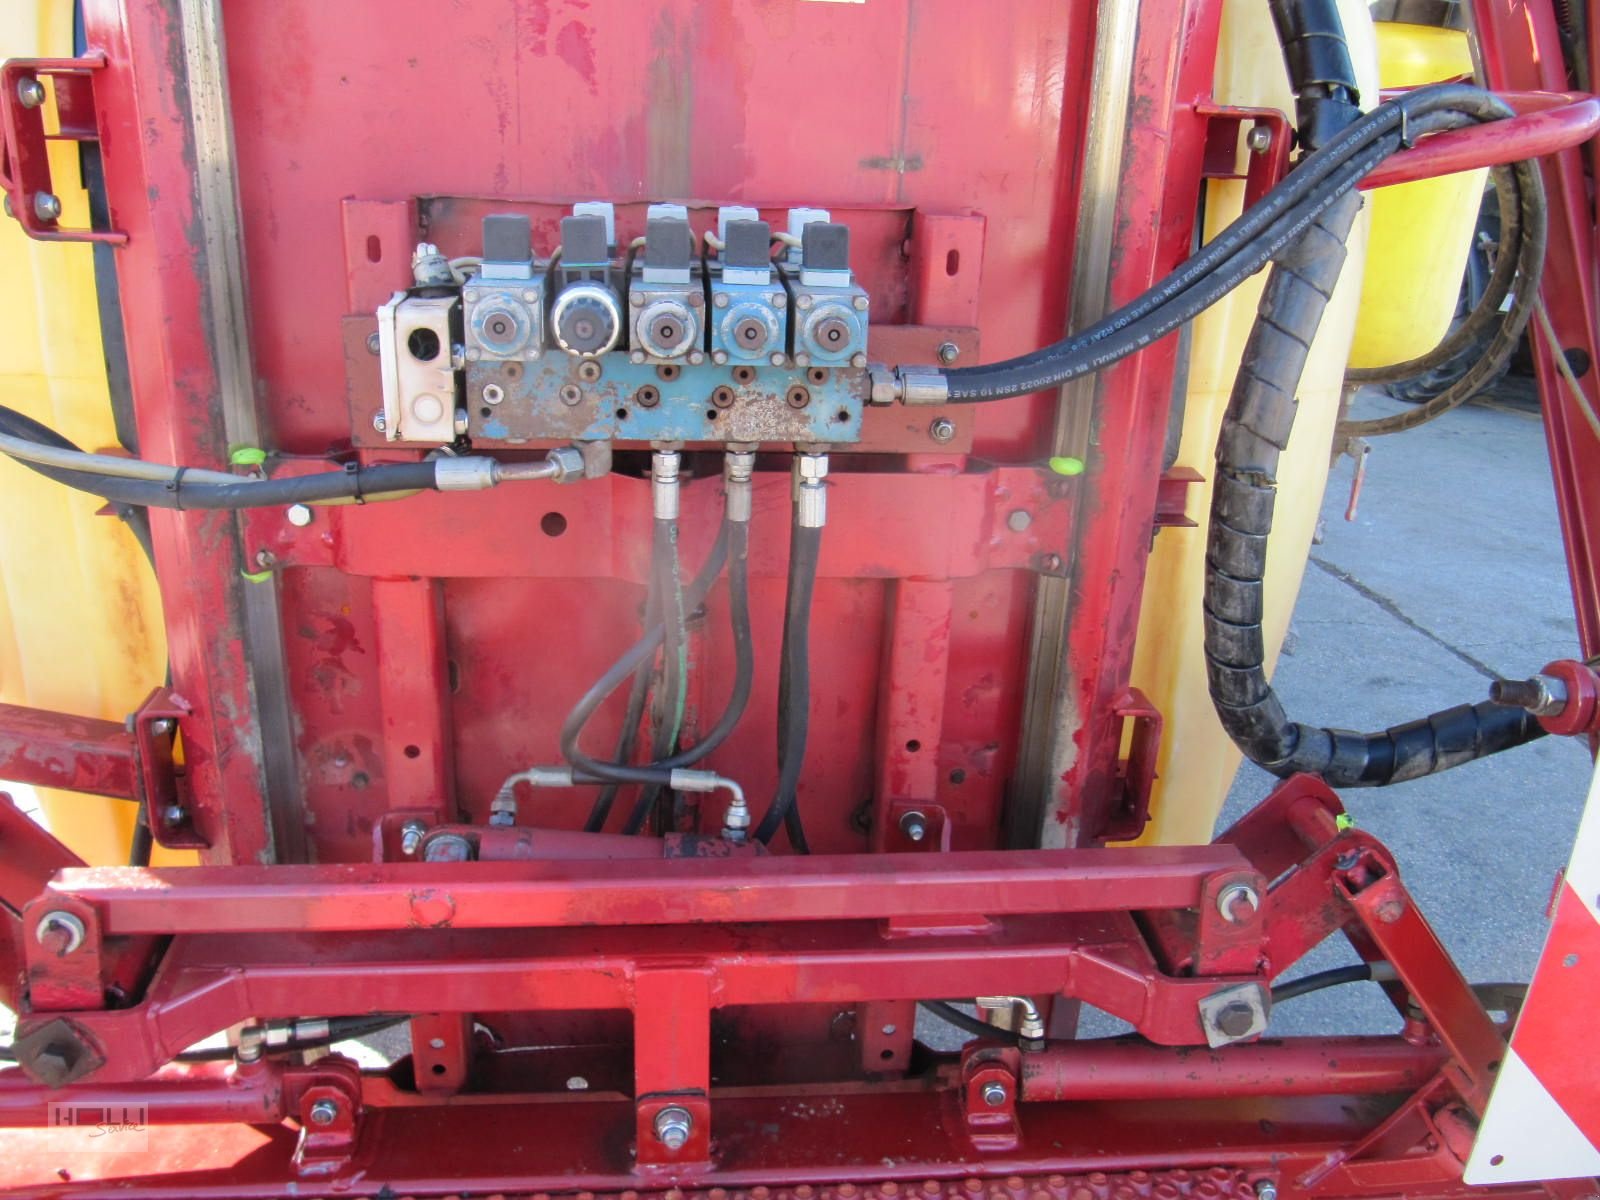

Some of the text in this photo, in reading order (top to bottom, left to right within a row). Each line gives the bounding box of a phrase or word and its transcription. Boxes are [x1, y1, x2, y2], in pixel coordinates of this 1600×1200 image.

[1237, 205, 1273, 236] MANULI
[1207, 245, 1225, 261] DIN
[1180, 258, 1209, 282] 20022
[1162, 278, 1183, 296] 2SN
[1130, 301, 1151, 317] SAE
[1113, 314, 1130, 329] 100
[1092, 342, 1134, 366] MANULI
[1052, 366, 1072, 382] DIN
[995, 383, 1018, 394] 2SN
[1020, 374, 1053, 391] 20022
[953, 388, 977, 397] SAE
[980, 387, 992, 395] 10
